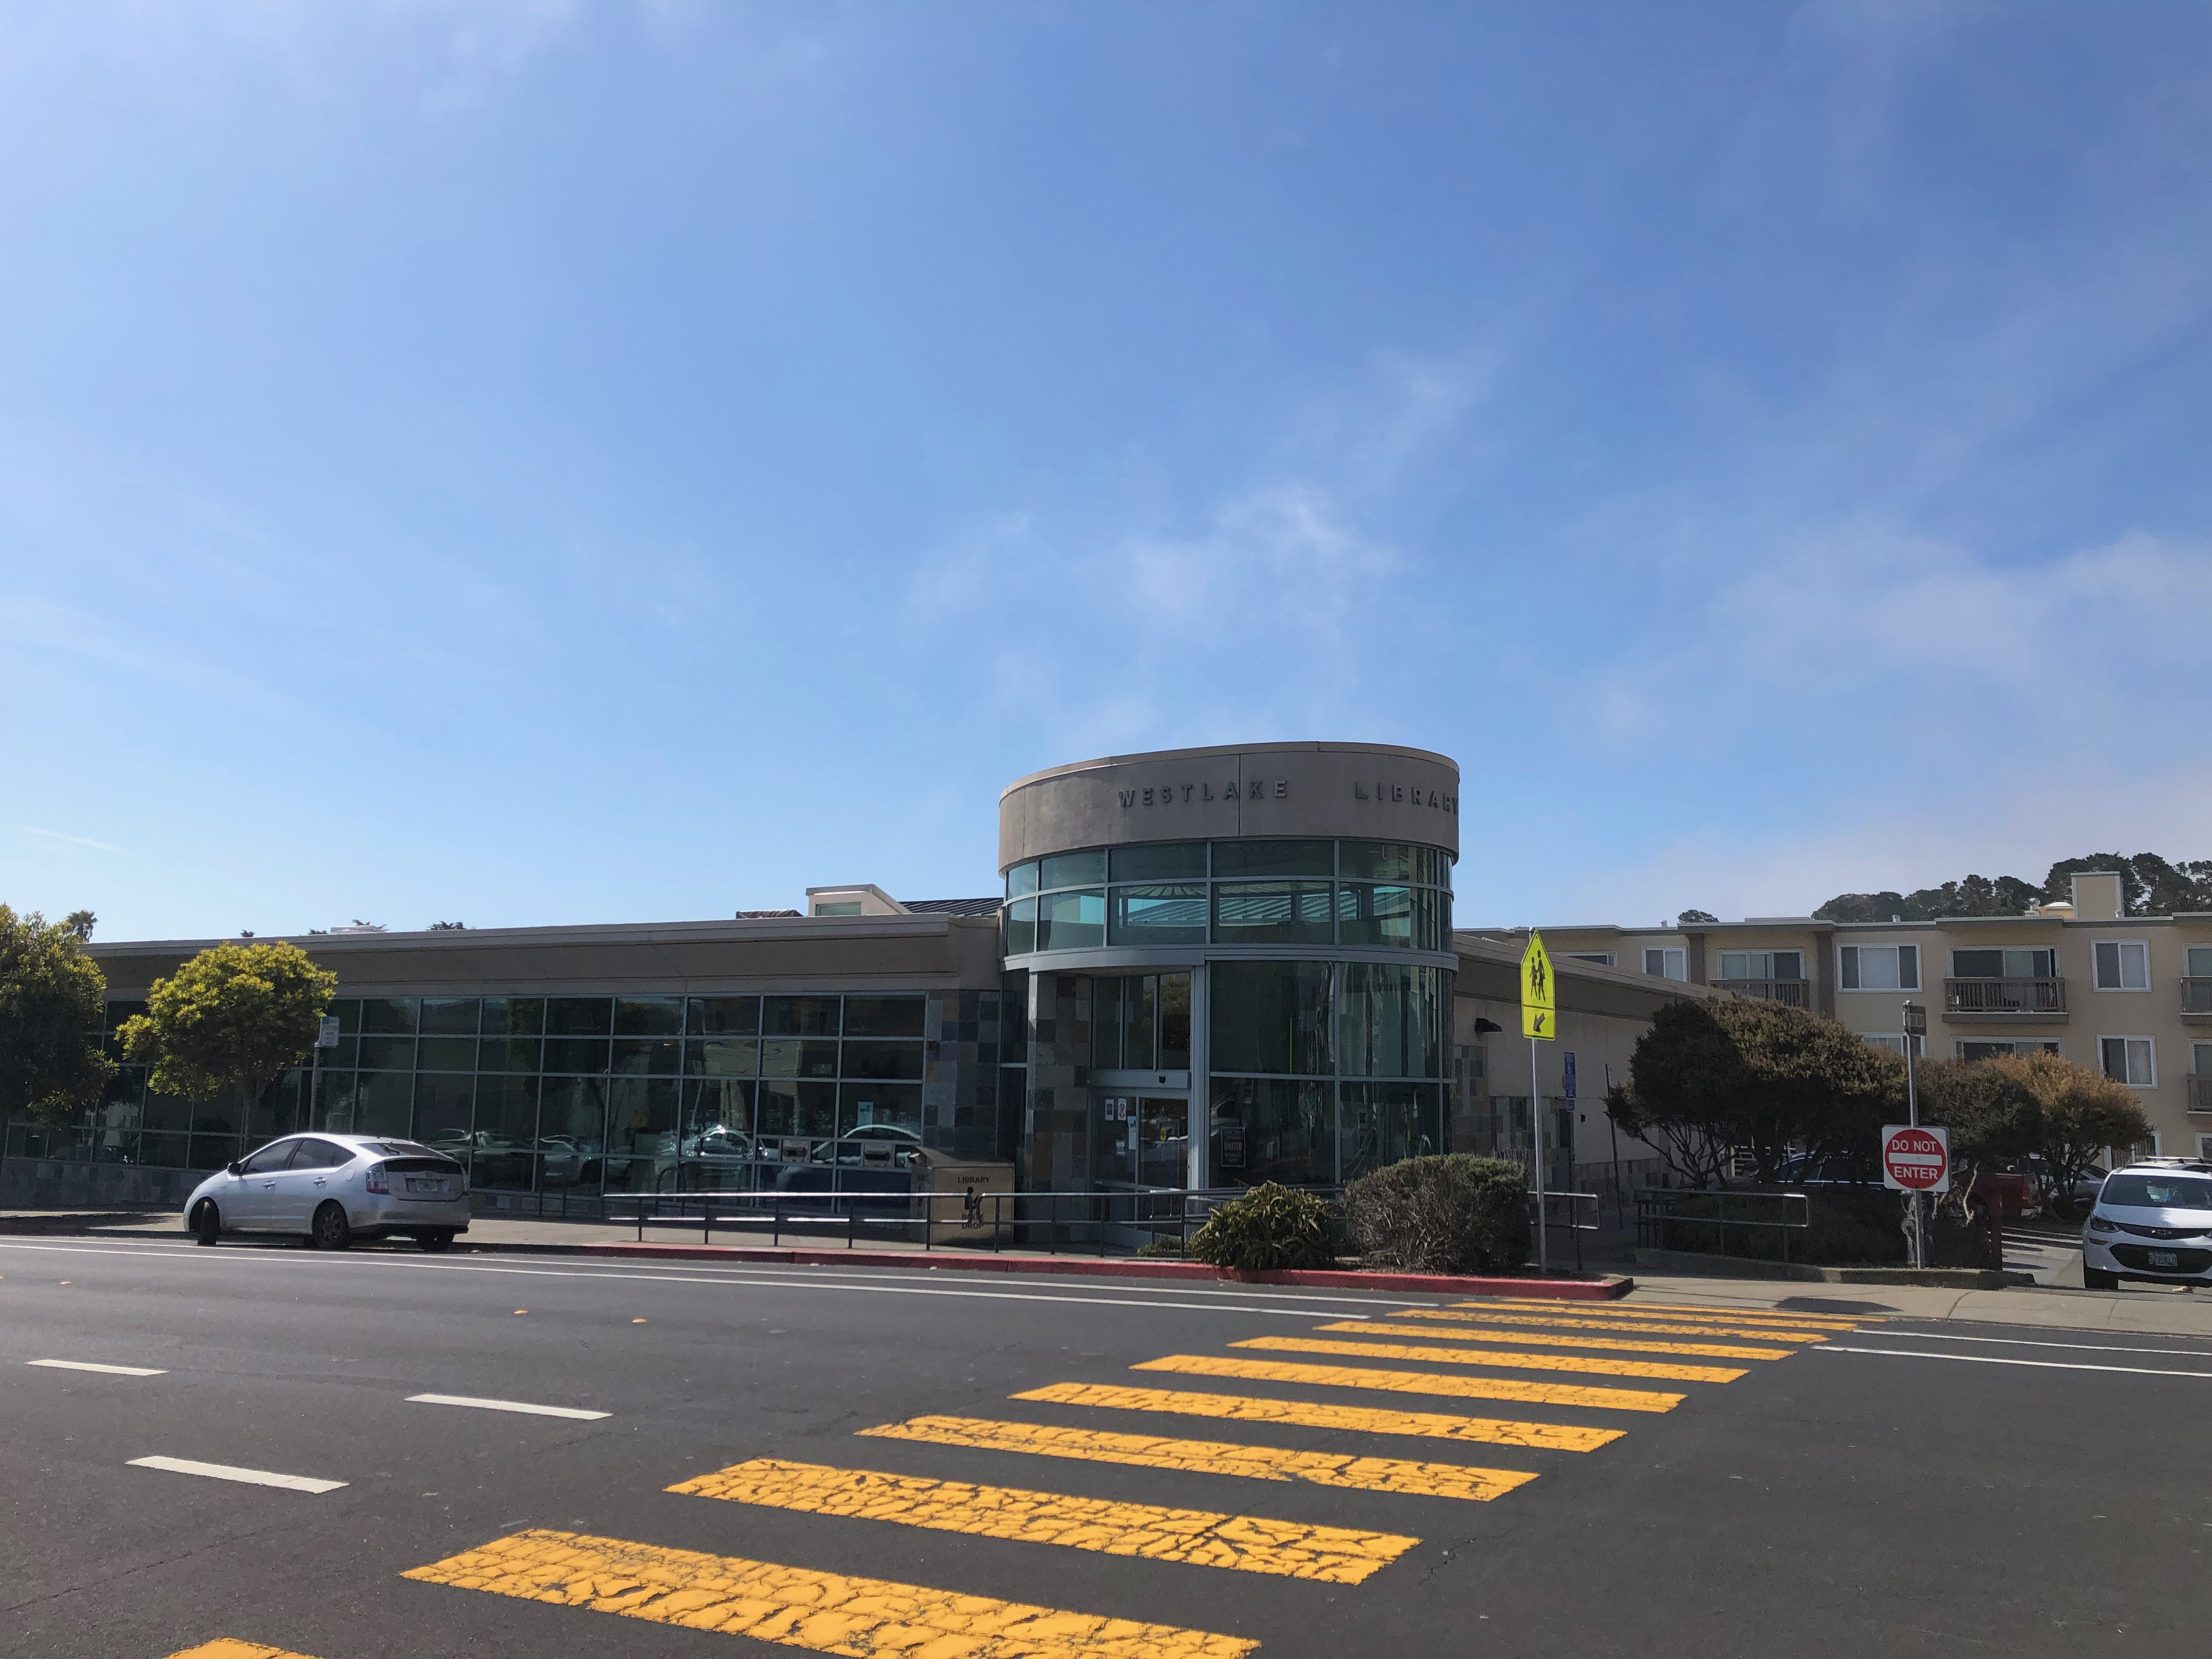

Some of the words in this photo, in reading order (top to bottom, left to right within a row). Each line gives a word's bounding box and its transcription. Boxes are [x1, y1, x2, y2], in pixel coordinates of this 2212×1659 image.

[1119, 780, 1287, 808] WESTLAKE
[1892, 1139, 1909, 1151] DO
[1913, 1141, 1937, 1152] NOT
[1894, 1166, 1938, 1180] ENTER
